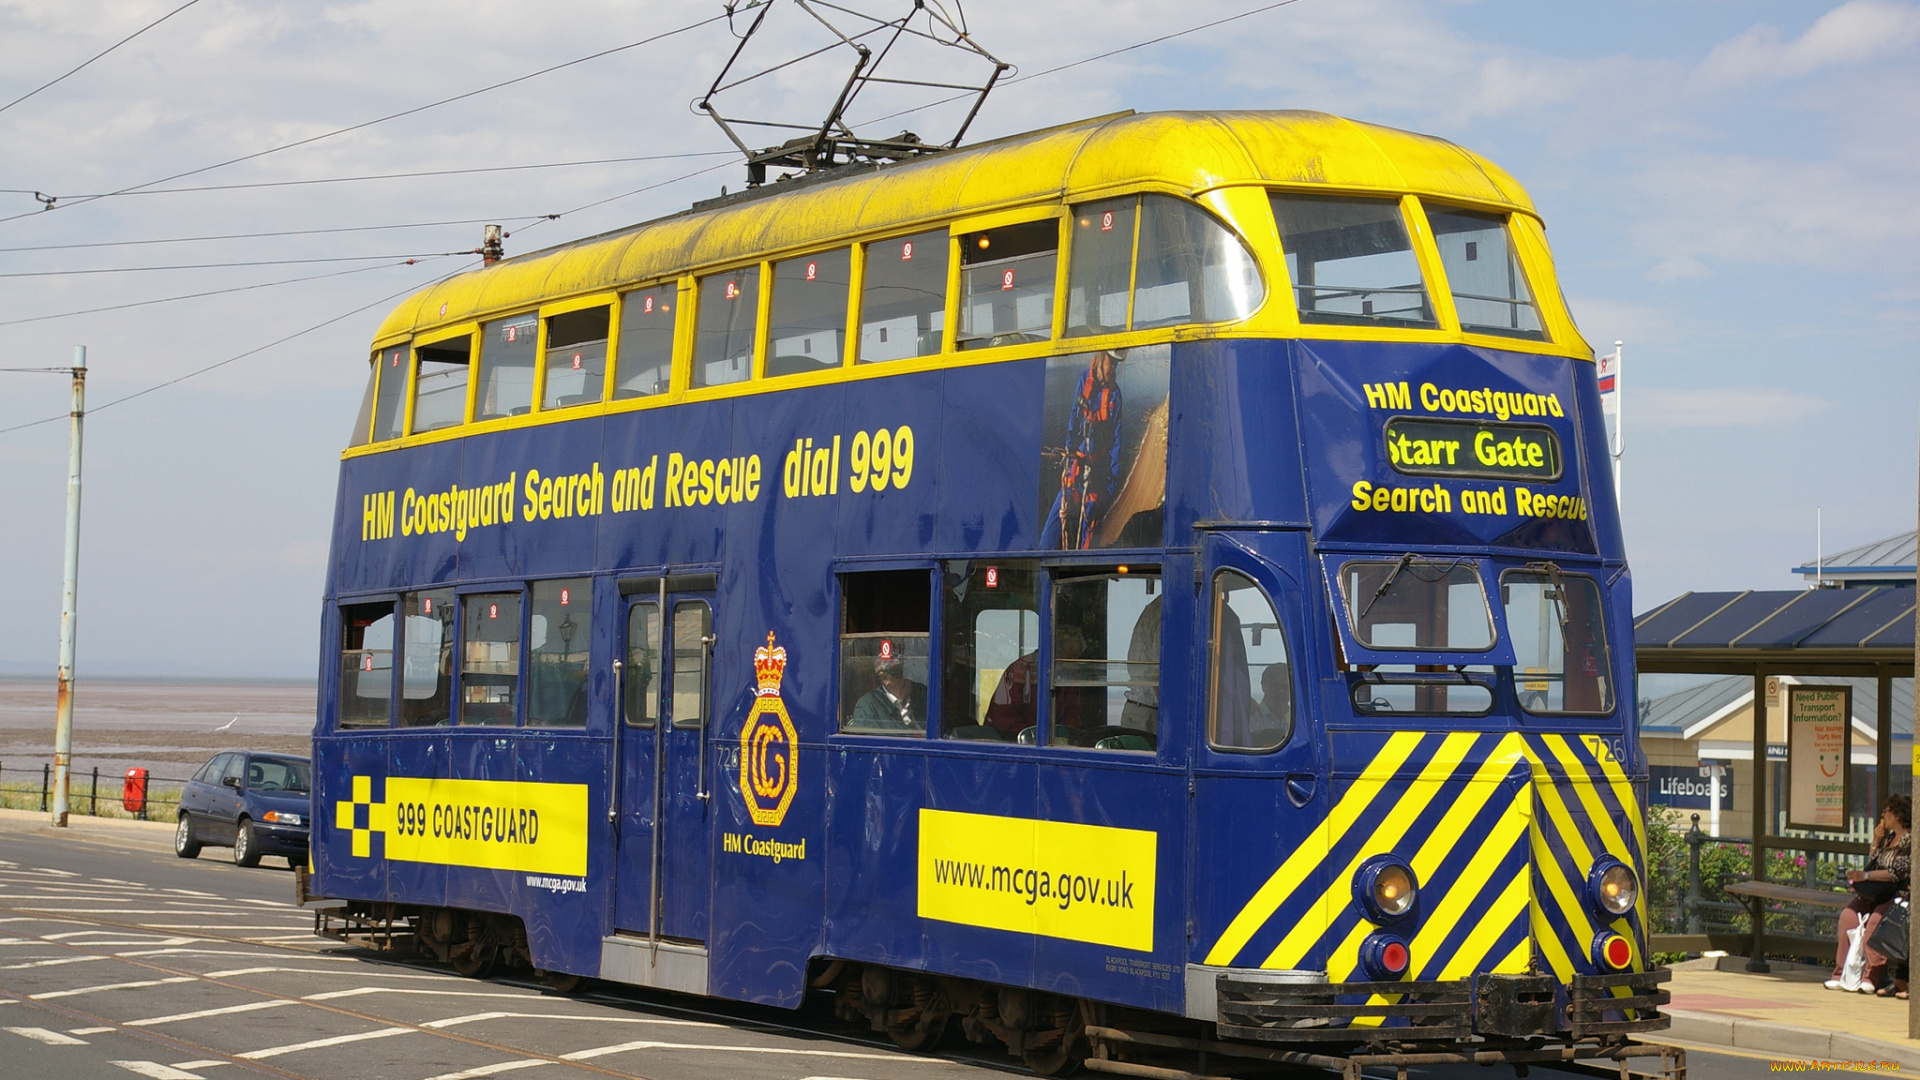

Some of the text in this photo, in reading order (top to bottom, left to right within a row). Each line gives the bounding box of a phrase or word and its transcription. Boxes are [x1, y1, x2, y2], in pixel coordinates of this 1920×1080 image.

[1363, 382, 1564, 421] HM Coastguard
[1388, 429, 1544, 468] Starr Gate
[362, 425, 914, 542] HM Coastguard Search and Rescue dial 999
[1352, 480, 1588, 521] Search and Rescue
[1796, 692, 1839, 701] Need Public
[1800, 703, 1835, 713] Transport
[1794, 713, 1842, 722] Information?
[717, 747, 739, 767] 726
[1589, 738, 1625, 763] 726
[1660, 777, 1728, 798] Lifeboas
[397, 802, 539, 845] 999 COASTGUARD
[723, 833, 805, 864] HM Coastguard
[526, 876, 587, 894] www.mcga.gov.uk
[935, 858, 1134, 910] www.mcga.gov.uk
